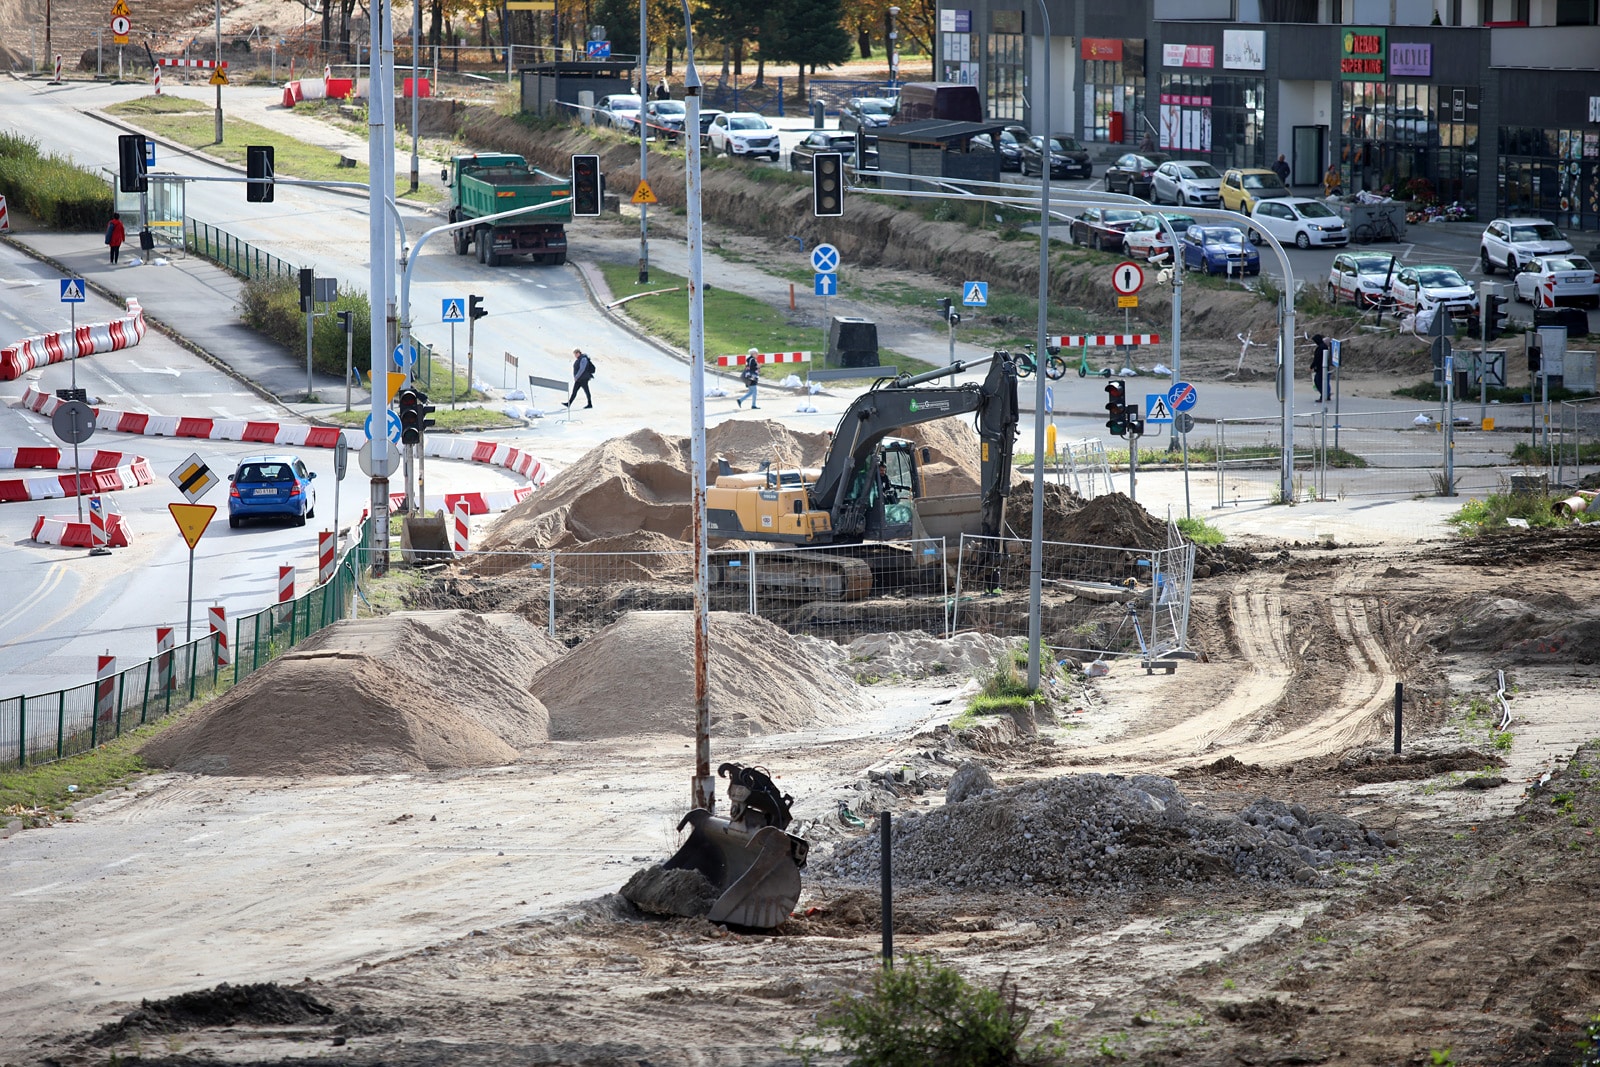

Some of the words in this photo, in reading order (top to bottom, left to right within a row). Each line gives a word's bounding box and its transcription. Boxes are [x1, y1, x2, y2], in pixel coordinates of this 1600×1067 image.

[1354, 34, 1380, 53] KEBAB
[1341, 58, 1363, 73] SUPER
[1364, 59, 1382, 74] KING
[1393, 49, 1428, 66] BADYLE
